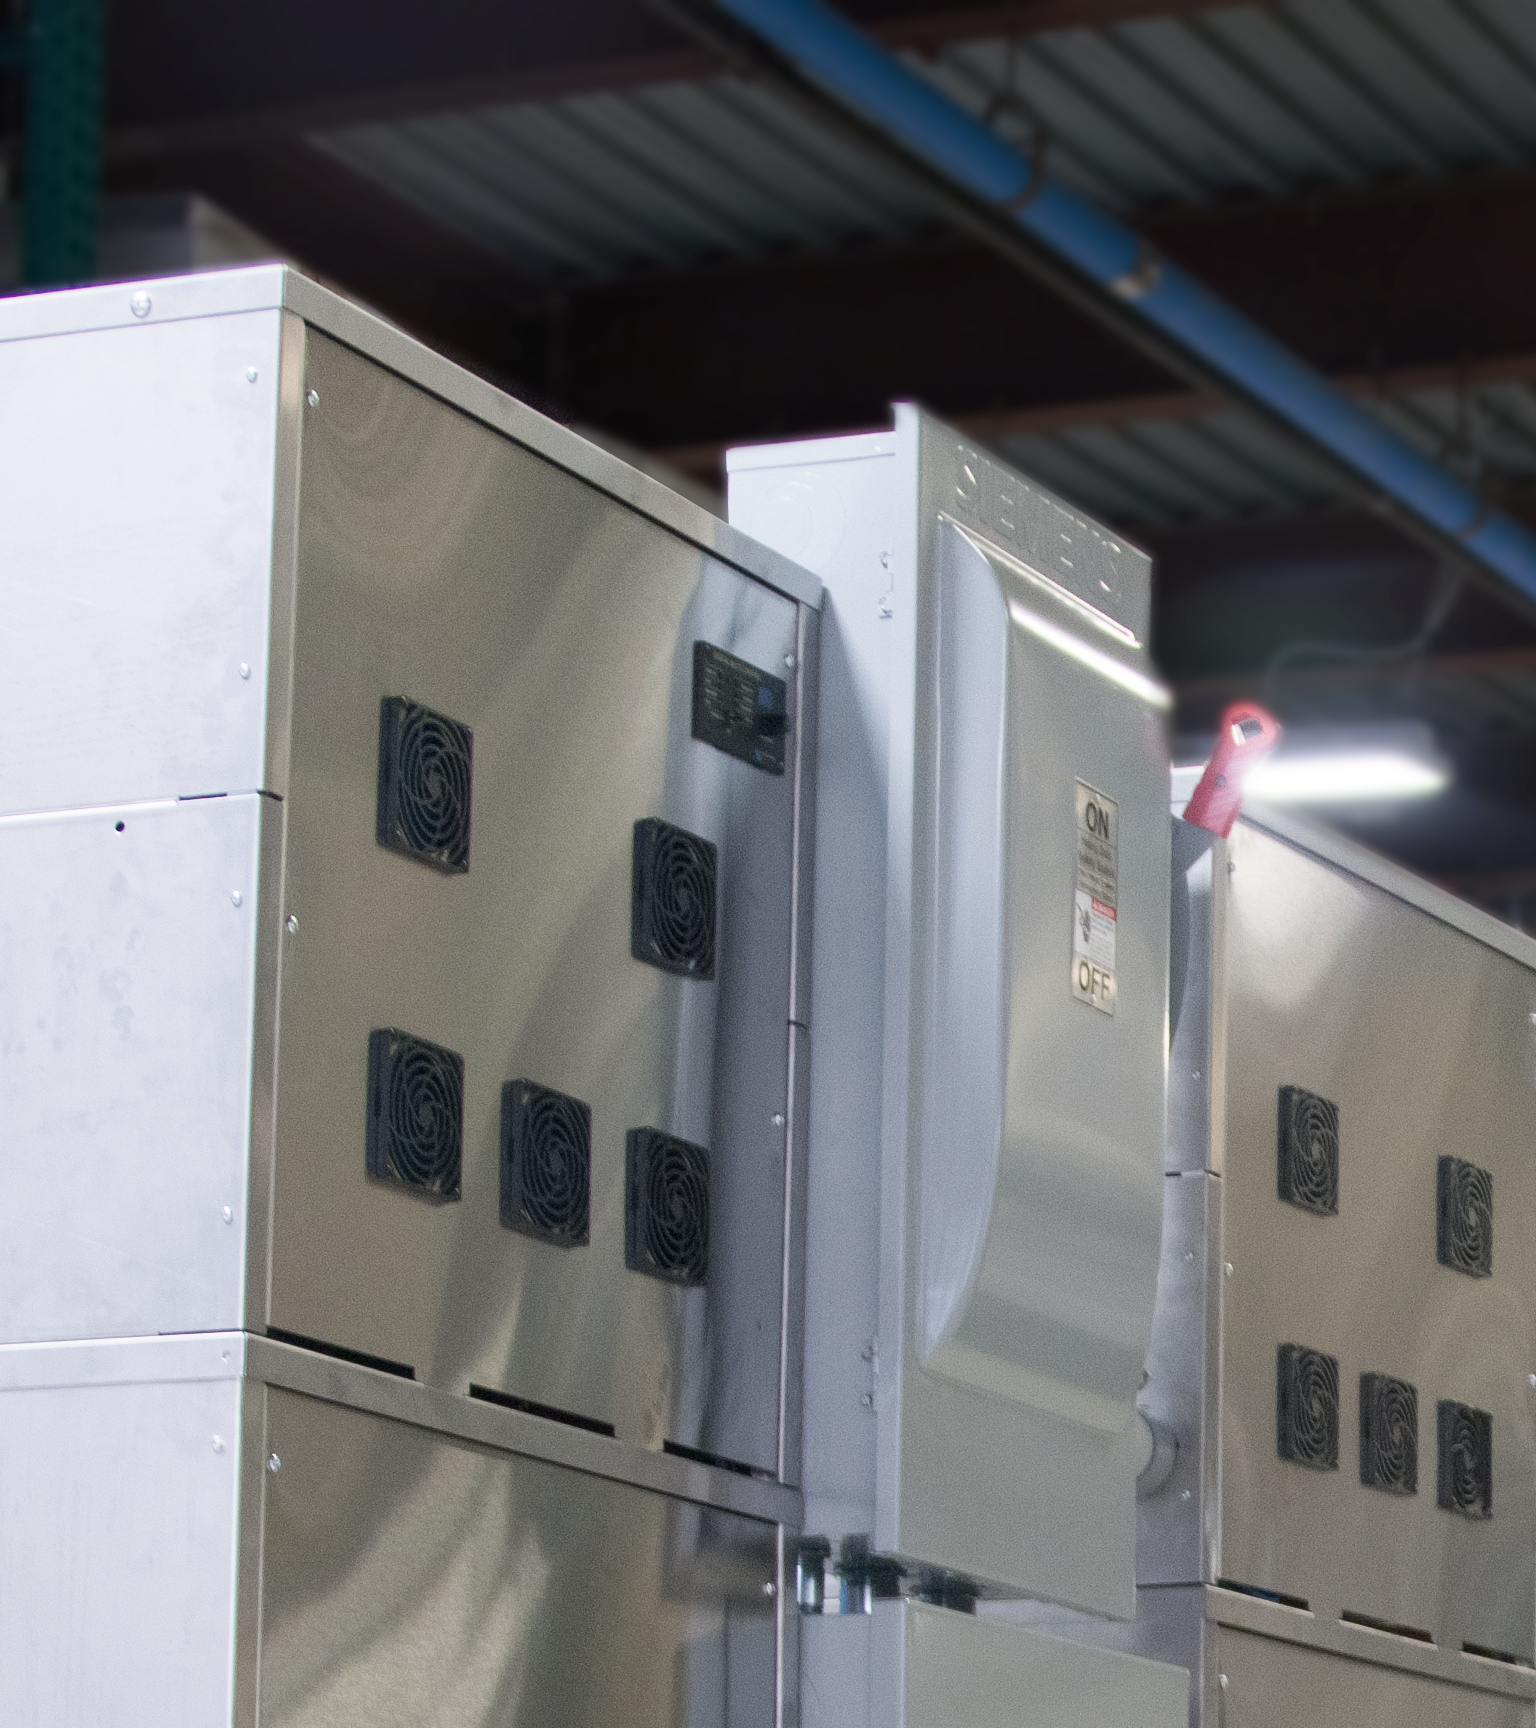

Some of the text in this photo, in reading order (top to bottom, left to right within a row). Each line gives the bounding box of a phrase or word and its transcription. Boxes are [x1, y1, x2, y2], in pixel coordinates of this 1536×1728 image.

[953, 444, 1125, 604] SIEMENS
[1085, 801, 1109, 840] ON
[1078, 960, 1111, 1001] OFF
